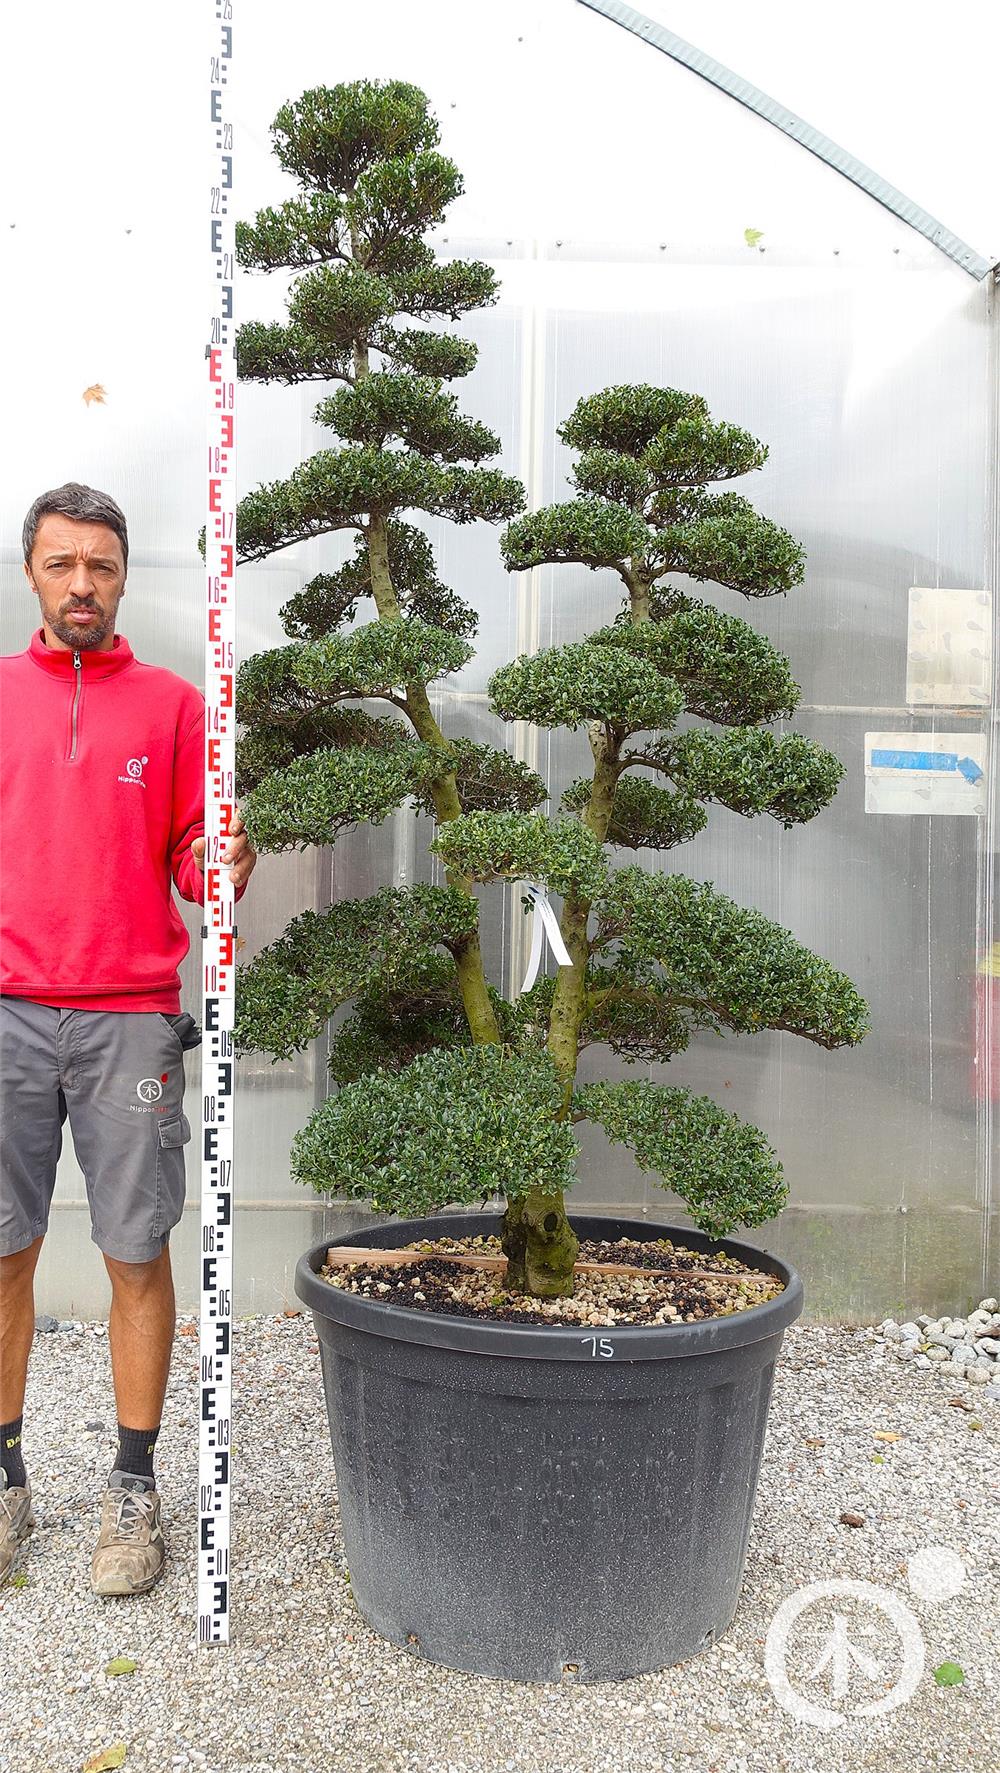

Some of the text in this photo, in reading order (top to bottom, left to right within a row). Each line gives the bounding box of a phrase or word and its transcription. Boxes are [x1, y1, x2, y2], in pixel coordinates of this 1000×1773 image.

[211, 58, 219, 84] 24
[223, 124, 233, 149] 23
[211, 188, 220, 214] 22
[223, 254, 233, 280] 21
[211, 318, 220, 344] 20
[222, 383, 233, 409] 19
[209, 447, 220, 473] 18
[222, 513, 233, 538] 17
[208, 577, 219, 603] 16
[222, 642, 233, 668] 15
[208, 707, 219, 733] 14
[221, 772, 233, 798] 13
[207, 837, 218, 863] 12
[222, 901, 232, 926] 11
[205, 966, 216, 991] 10
[205, 1096, 215, 1122] 08
[220, 1160, 231, 1186] 07
[203, 1226, 214, 1252] 06
[219, 1290, 230, 1316] 05
[202, 1356, 213, 1381] 04
[218, 1420, 229, 1445] 03
[201, 1485, 212, 1512] 02
[217, 1549, 227, 1575] 01
[200, 1615, 211, 1641] 00
